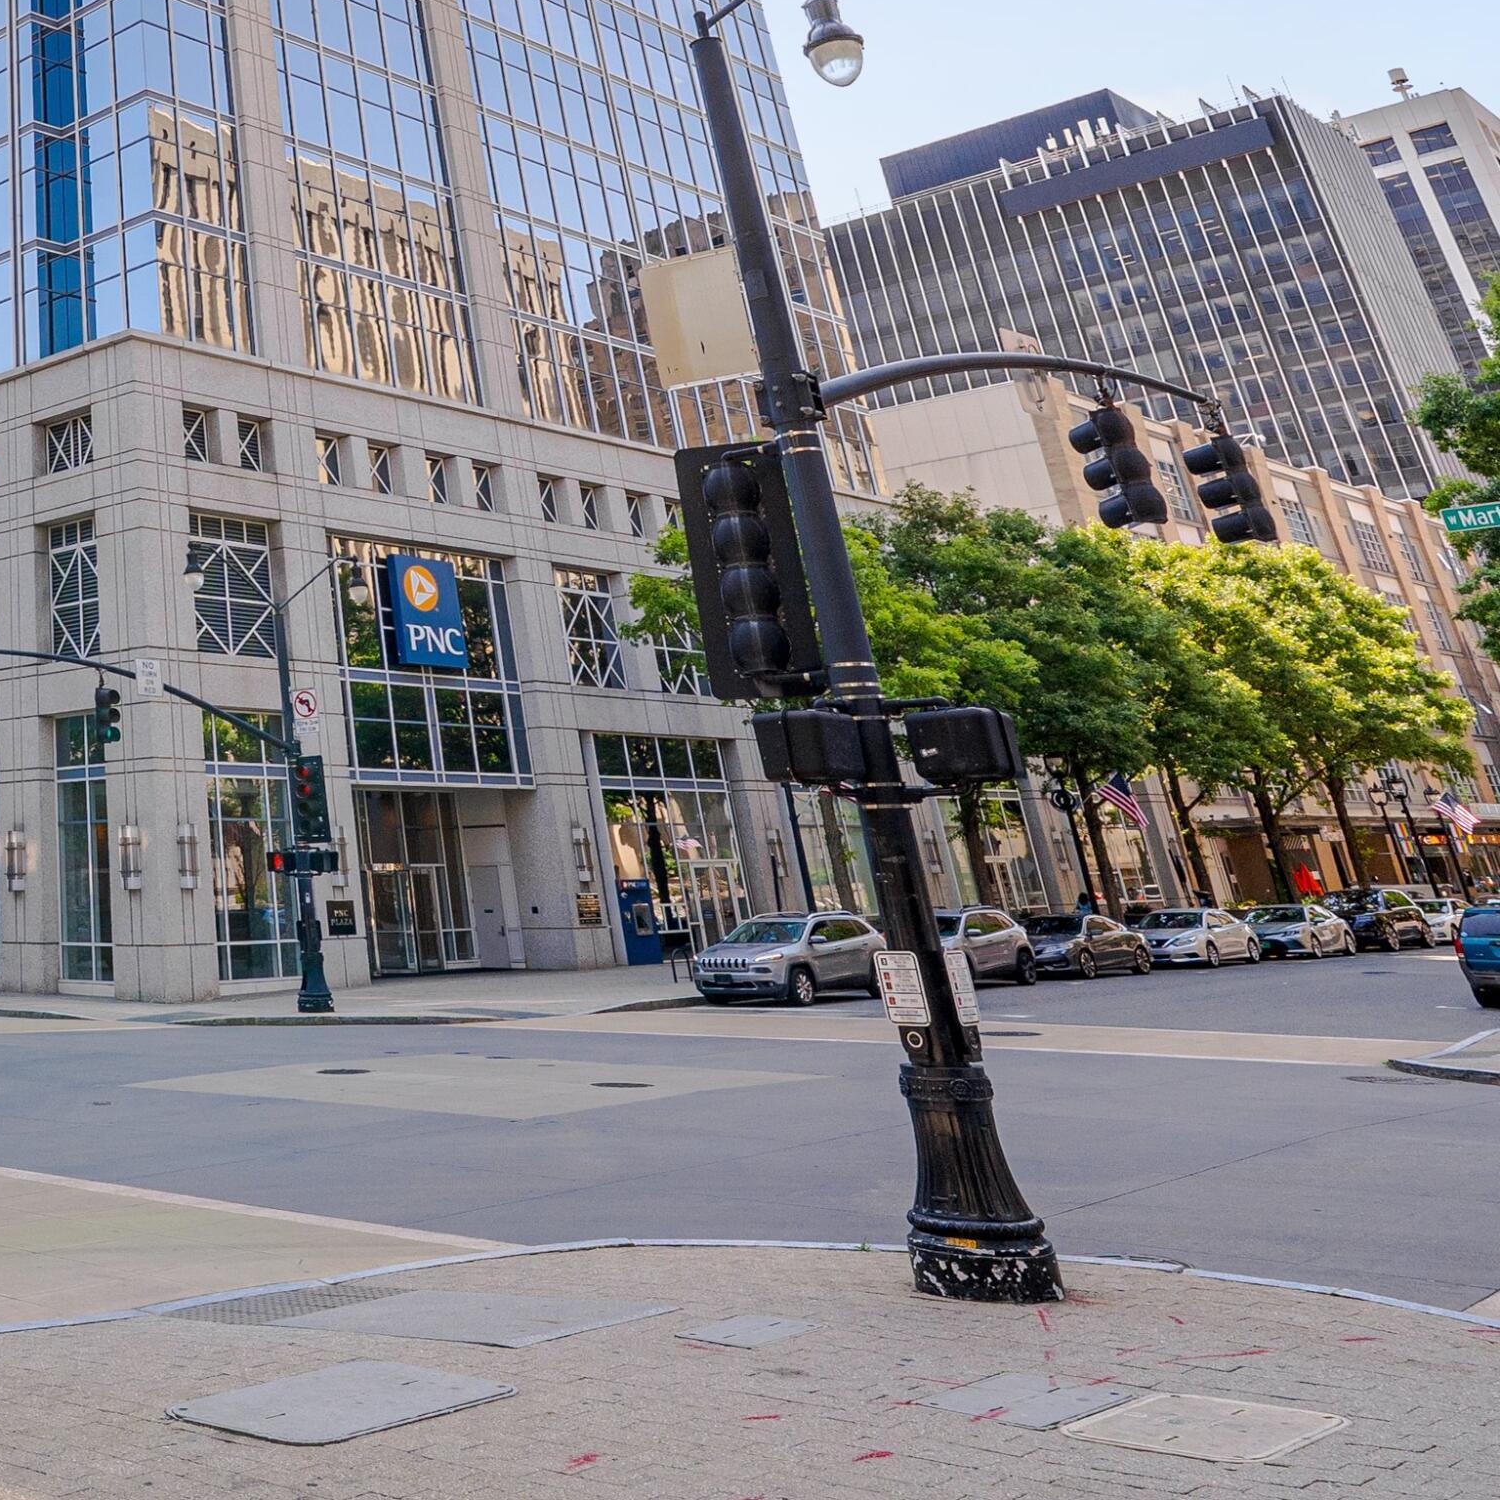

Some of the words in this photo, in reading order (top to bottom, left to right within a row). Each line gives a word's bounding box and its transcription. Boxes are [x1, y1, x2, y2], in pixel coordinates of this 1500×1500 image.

[405, 623, 464, 656] PNC
[142, 661, 154, 670] NO
[333, 909, 349, 917] PNC
[331, 918, 354, 926] PLAZA
